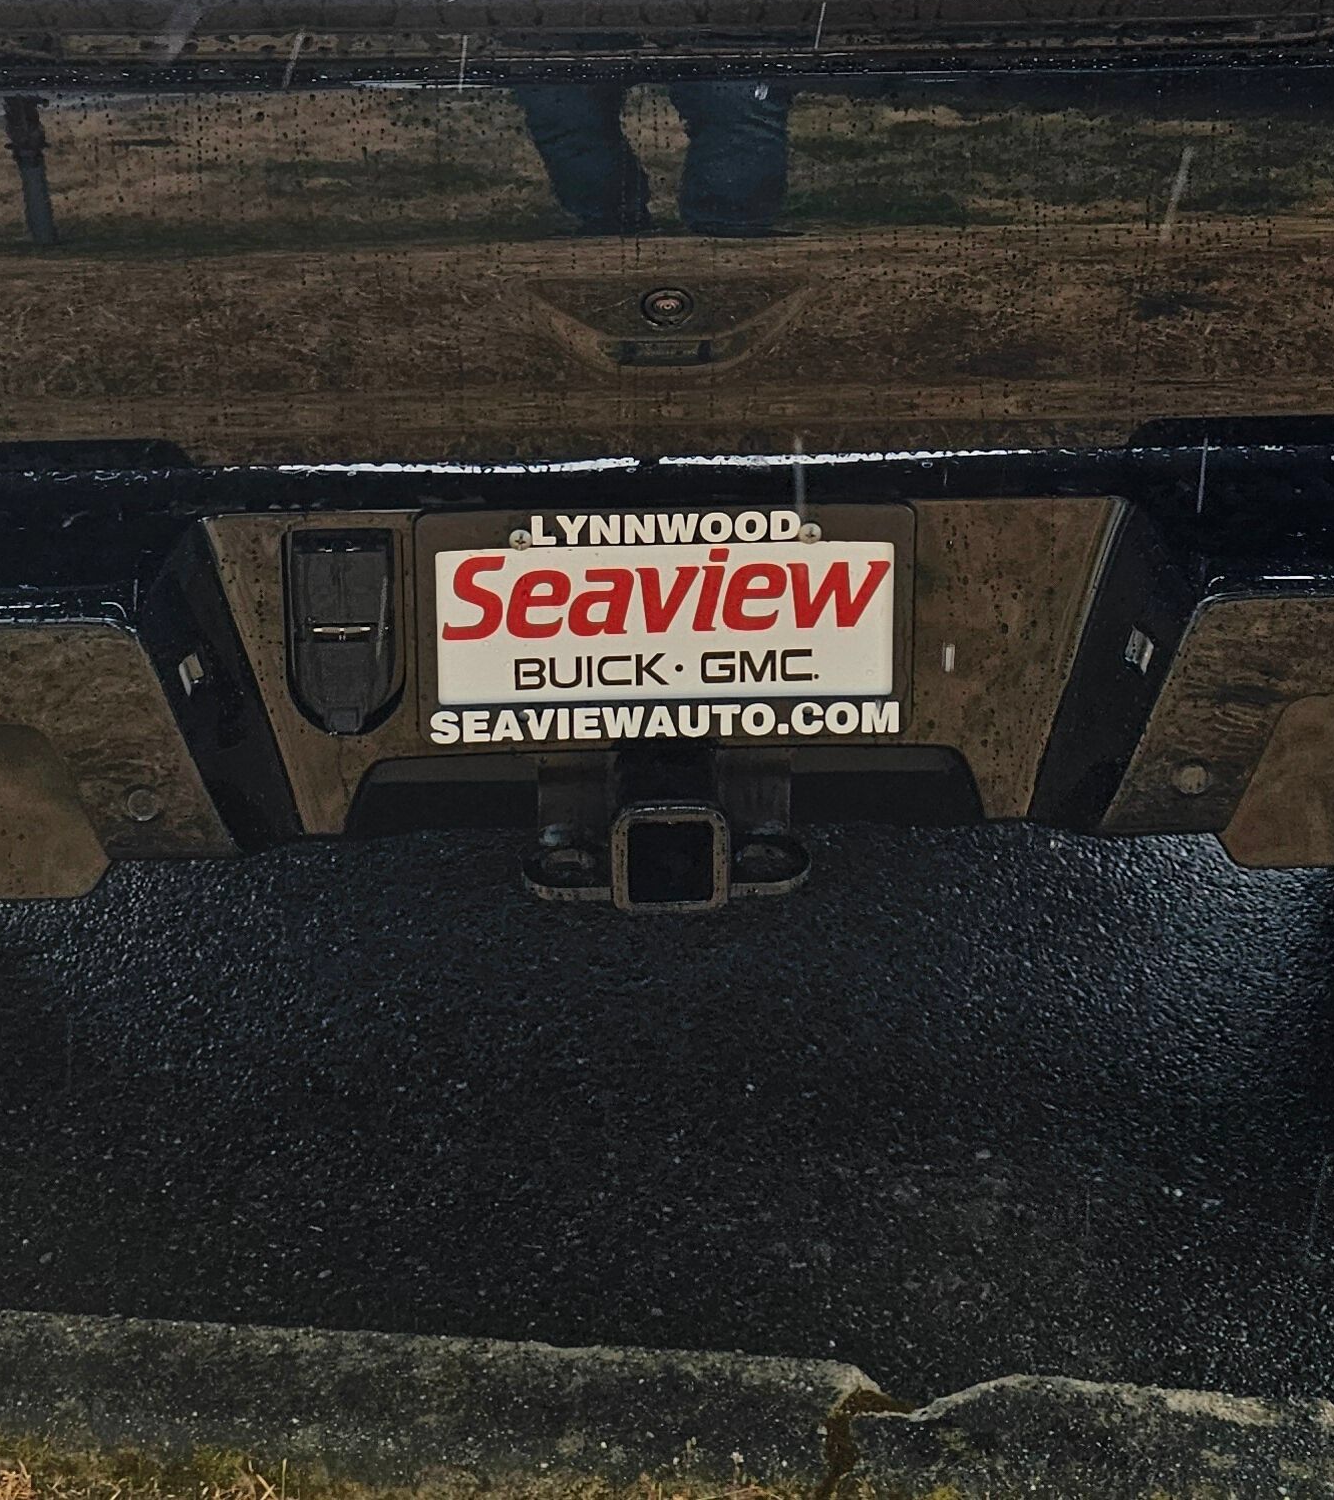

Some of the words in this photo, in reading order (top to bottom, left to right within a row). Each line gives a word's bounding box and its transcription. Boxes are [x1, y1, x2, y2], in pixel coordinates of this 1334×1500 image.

[530, 510, 801, 547] LYNNWOOD
[441, 548, 891, 641] Seaview
[513, 652, 667, 691] BUICK
[429, 701, 901, 745] SEAVIEWAUTO.COM
